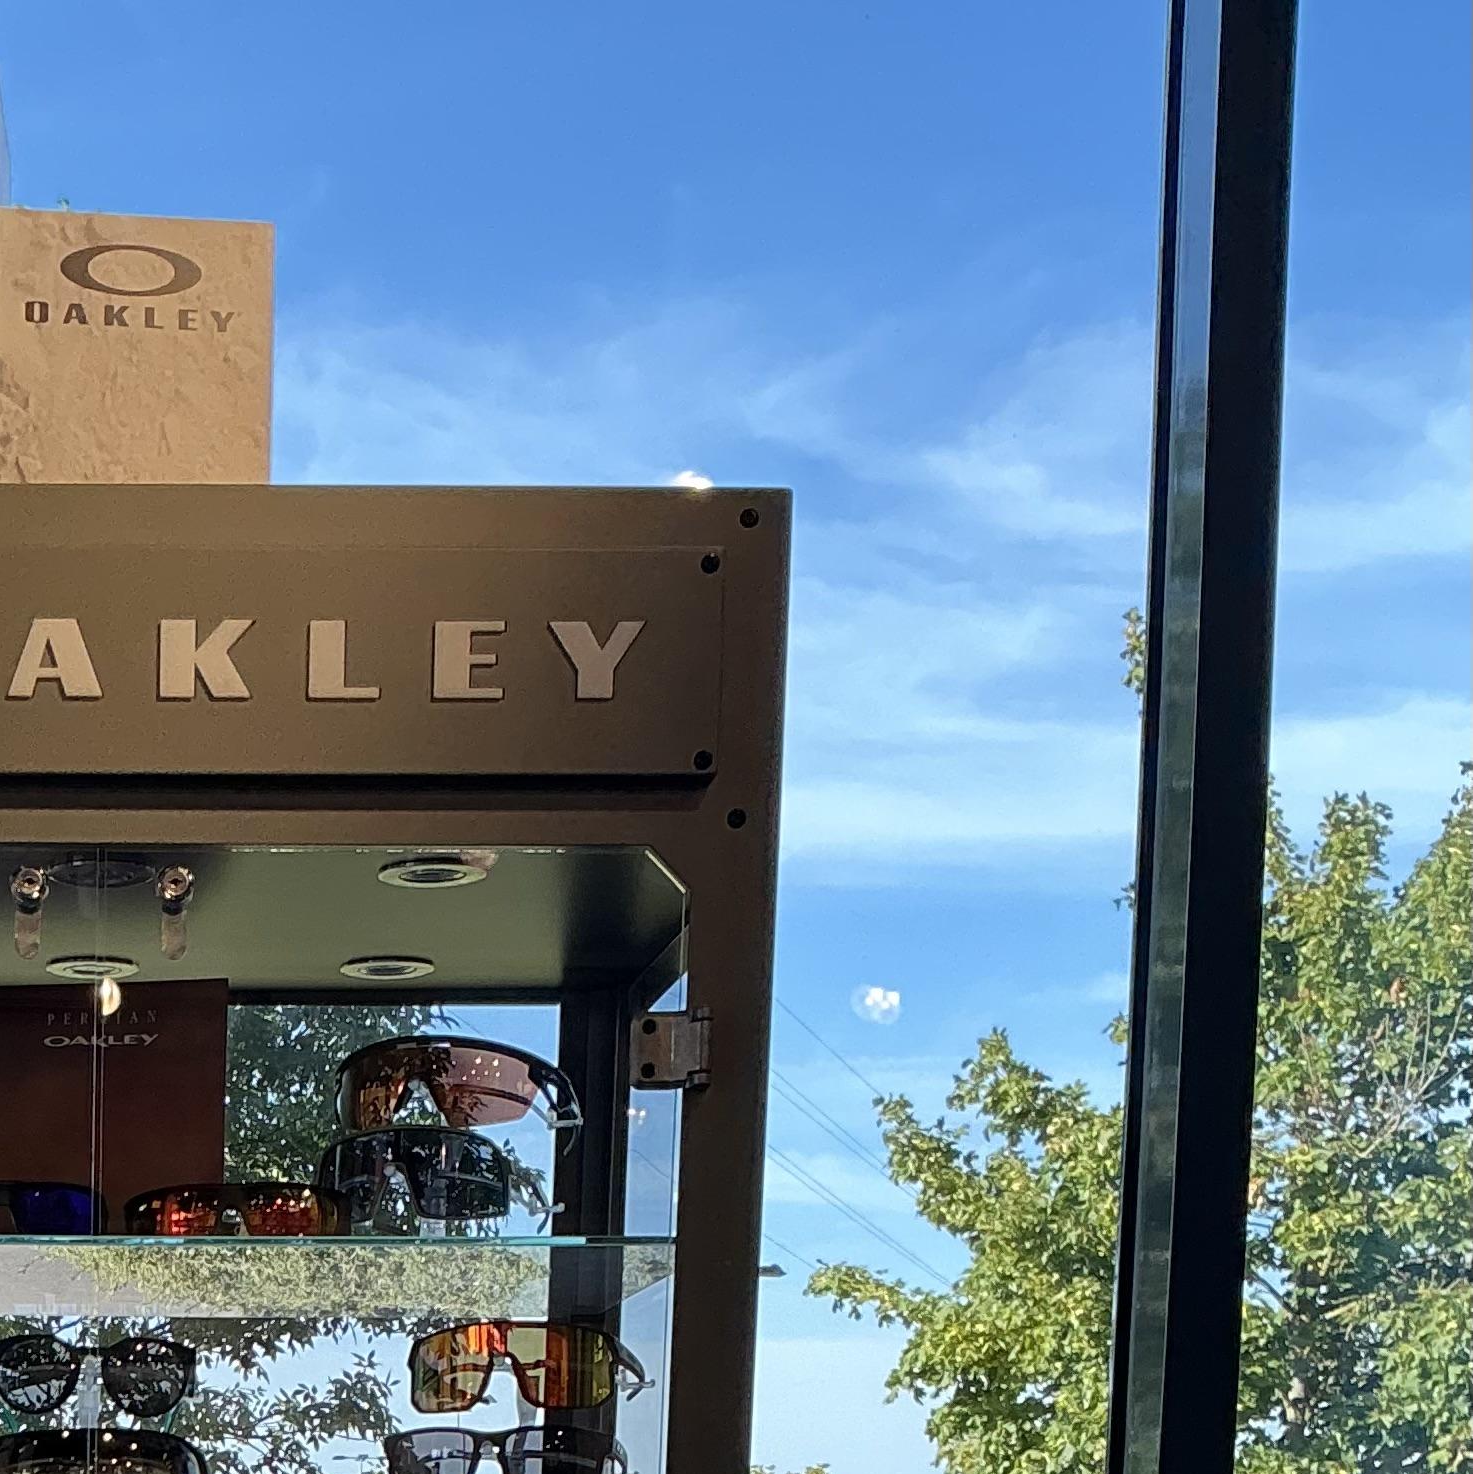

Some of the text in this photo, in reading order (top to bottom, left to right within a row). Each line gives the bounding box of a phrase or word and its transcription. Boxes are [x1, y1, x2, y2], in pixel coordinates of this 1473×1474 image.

[24, 300, 236, 333] OAKLEY
[46, 1009, 158, 1026] PERIAN
[43, 1032, 159, 1047] OAKLEY
